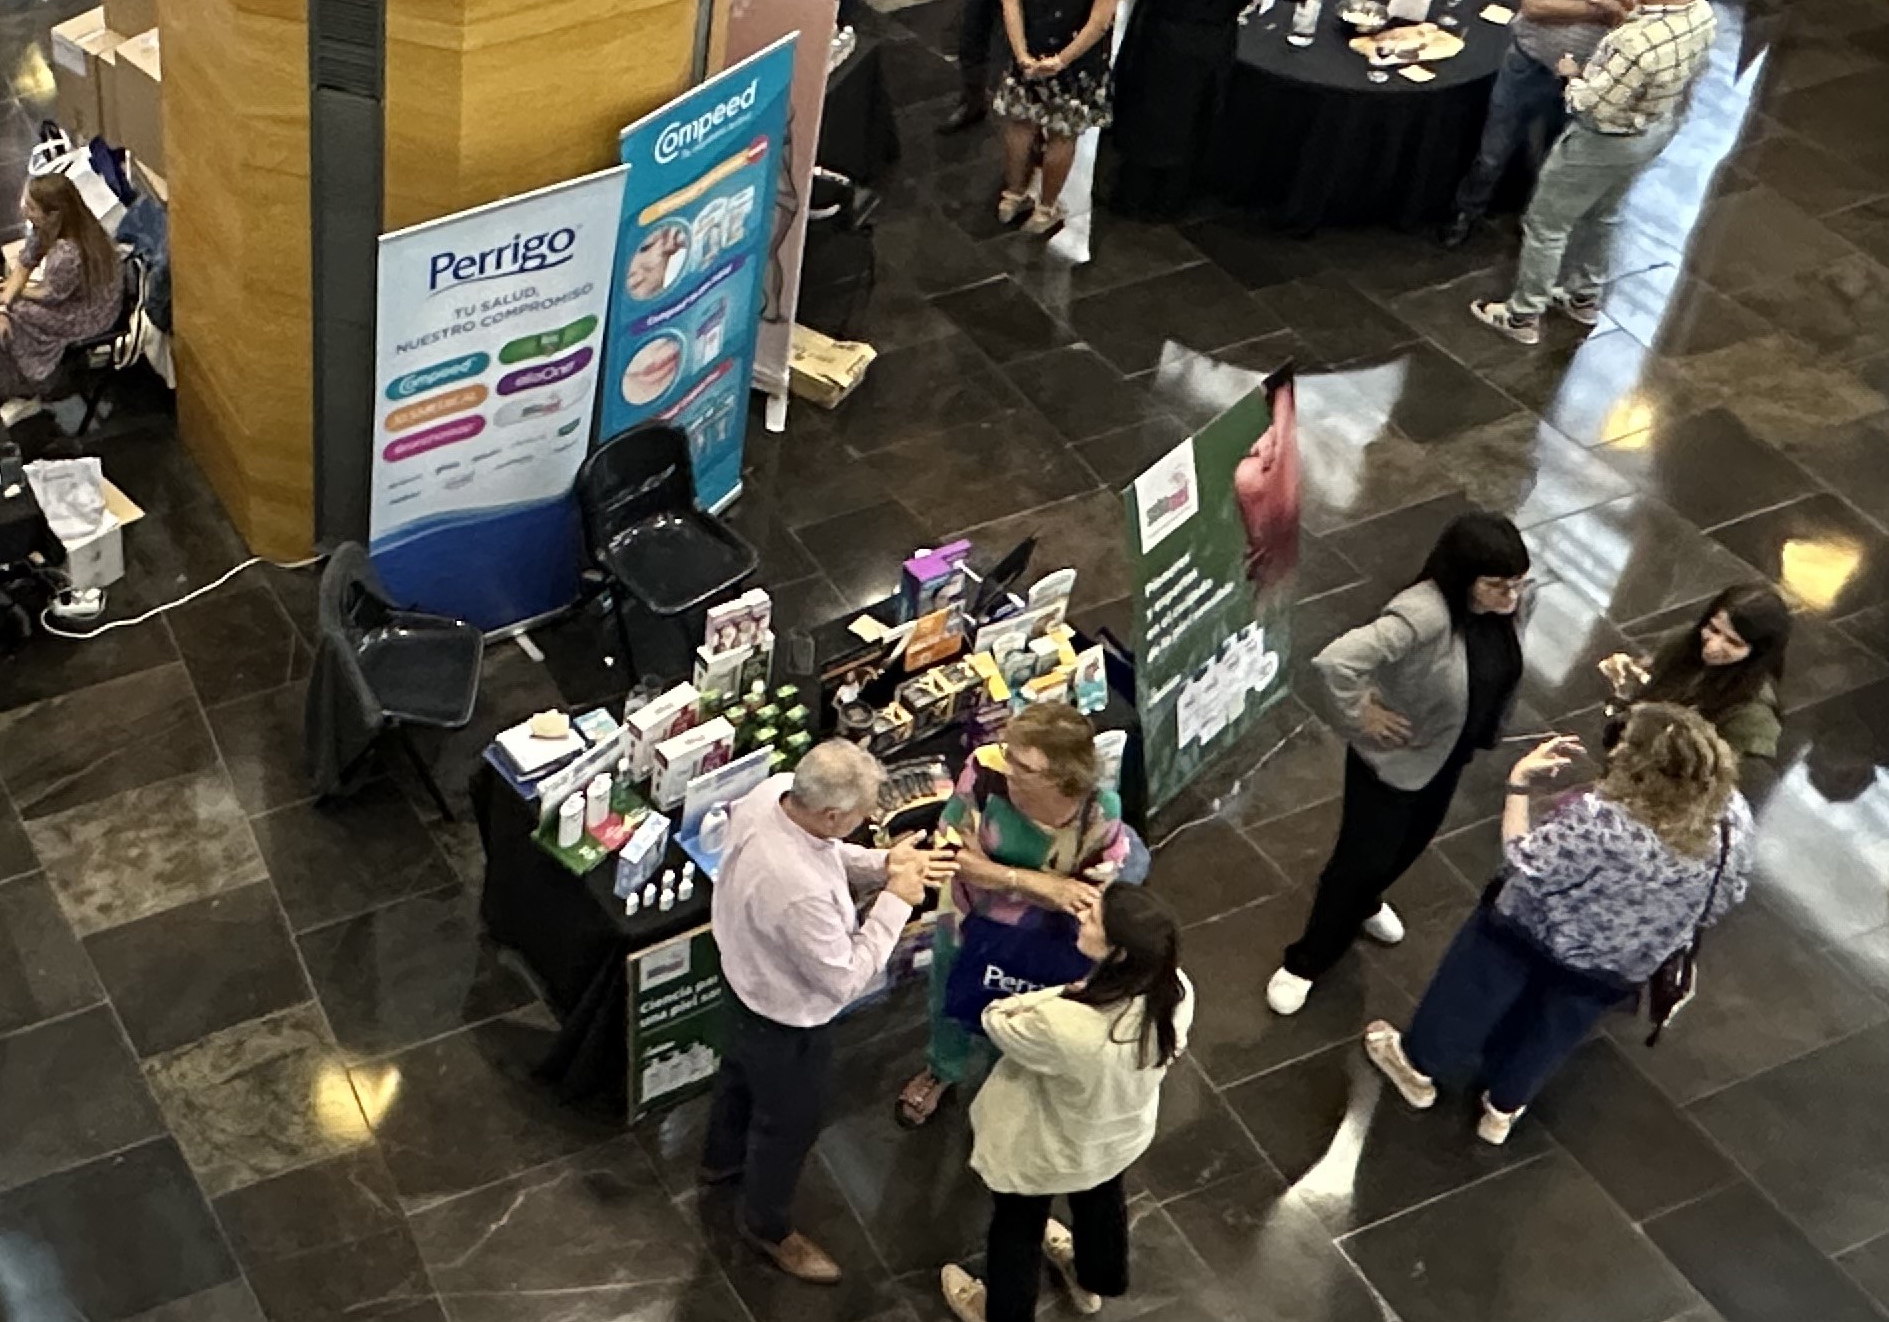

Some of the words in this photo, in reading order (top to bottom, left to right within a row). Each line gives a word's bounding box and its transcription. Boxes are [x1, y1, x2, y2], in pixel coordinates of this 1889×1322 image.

[654, 78, 759, 164] Compeed
[428, 227, 577, 291] Perrigo
[396, 320, 476, 354] NUESTRO
[480, 282, 594, 328] COMPROMISO
[454, 304, 476, 320] TU
[480, 286, 540, 312] SALUD,
[983, 964, 1045, 993] Perr
